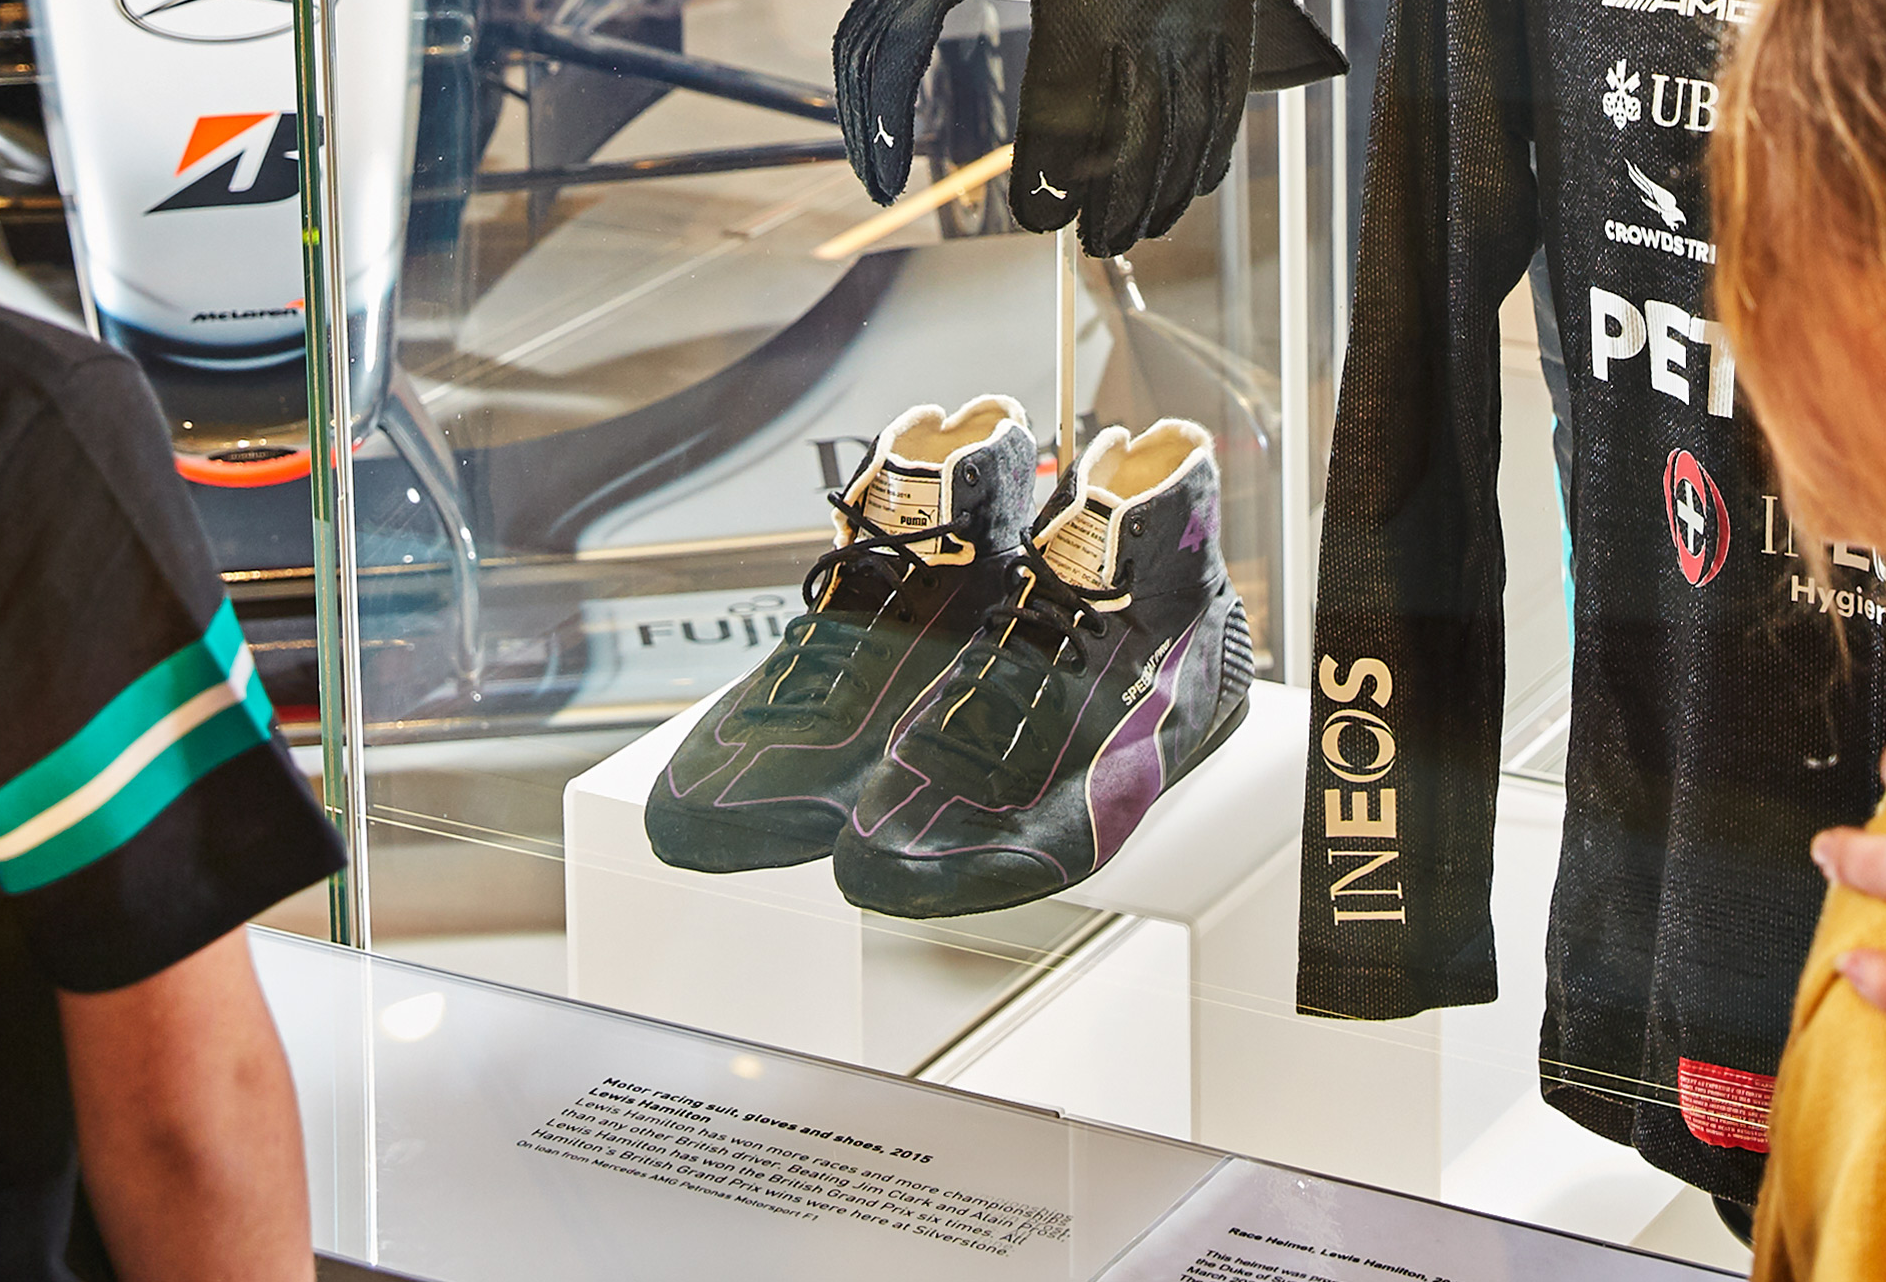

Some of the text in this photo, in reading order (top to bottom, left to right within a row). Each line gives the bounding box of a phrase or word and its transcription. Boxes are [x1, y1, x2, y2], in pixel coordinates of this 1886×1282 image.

[1651, 73, 1719, 133] UB
[1604, 219, 1716, 265] CROWDSTRI
[900, 515, 928, 526] PUMA
[1319, 654, 1406, 926] INEOS
[588, 1087, 710, 1123] Lewis Hamilton
[602, 1077, 933, 1163] Motor racing suit, gloves and shoes, 2015
[560, 1108, 595, 1122] than
[598, 1118, 628, 1130] any
[629, 1126, 673, 1140] other
[675, 1136, 728, 1155] British
[731, 1151, 780, 1169] driver.
[787, 1164, 849, 1187] Beating
[852, 1181, 883, 1194] Jim
[887, 1189, 932, 1206] Clark
[935, 1203, 970, 1215] and
[969, 1211, 1018, 1227] Alain
[575, 1097, 620, 1114] Lewis
[623, 1109, 694, 1132] Hamilton
[697, 1127, 727, 1140] has
[730, 1137, 763, 1150] won
[765, 1146, 809, 1161] more
[812, 1158, 857, 1173] races
[860, 1170, 894, 1182] and
[894, 1178, 939, 1193] more
[531, 1128, 1007, 1256] Hamilton's British Grand Prix wins were here at Silverstone.
[549, 1122, 591, 1135] Lewis
[594, 1130, 666, 1154] Hamilton
[669, 1149, 699, 1162] has
[702, 1158, 735, 1171] won
[738, 1166, 765, 1178] the
[768, 1173, 822, 1193] British
[827, 1188, 879, 1207] Grand
[879, 1201, 914, 1216] Prix
[916, 1213, 941, 1223] six
[944, 1219, 992, 1237] times.
[1186, 1266, 1226, 1282] March
[1195, 1258, 1215, 1268] the
[1218, 1263, 1253, 1277] Duke
[1206, 1249, 1231, 1262] This
[1235, 1257, 1279, 1273] helmet
[1281, 1268, 1307, 1279] was
[1228, 1227, 1263, 1241] Race
[1265, 1236, 1315, 1254] Helmet,
[1320, 1248, 1360, 1263] Lewis
[1363, 1258, 1428, 1282] Hamilton,
